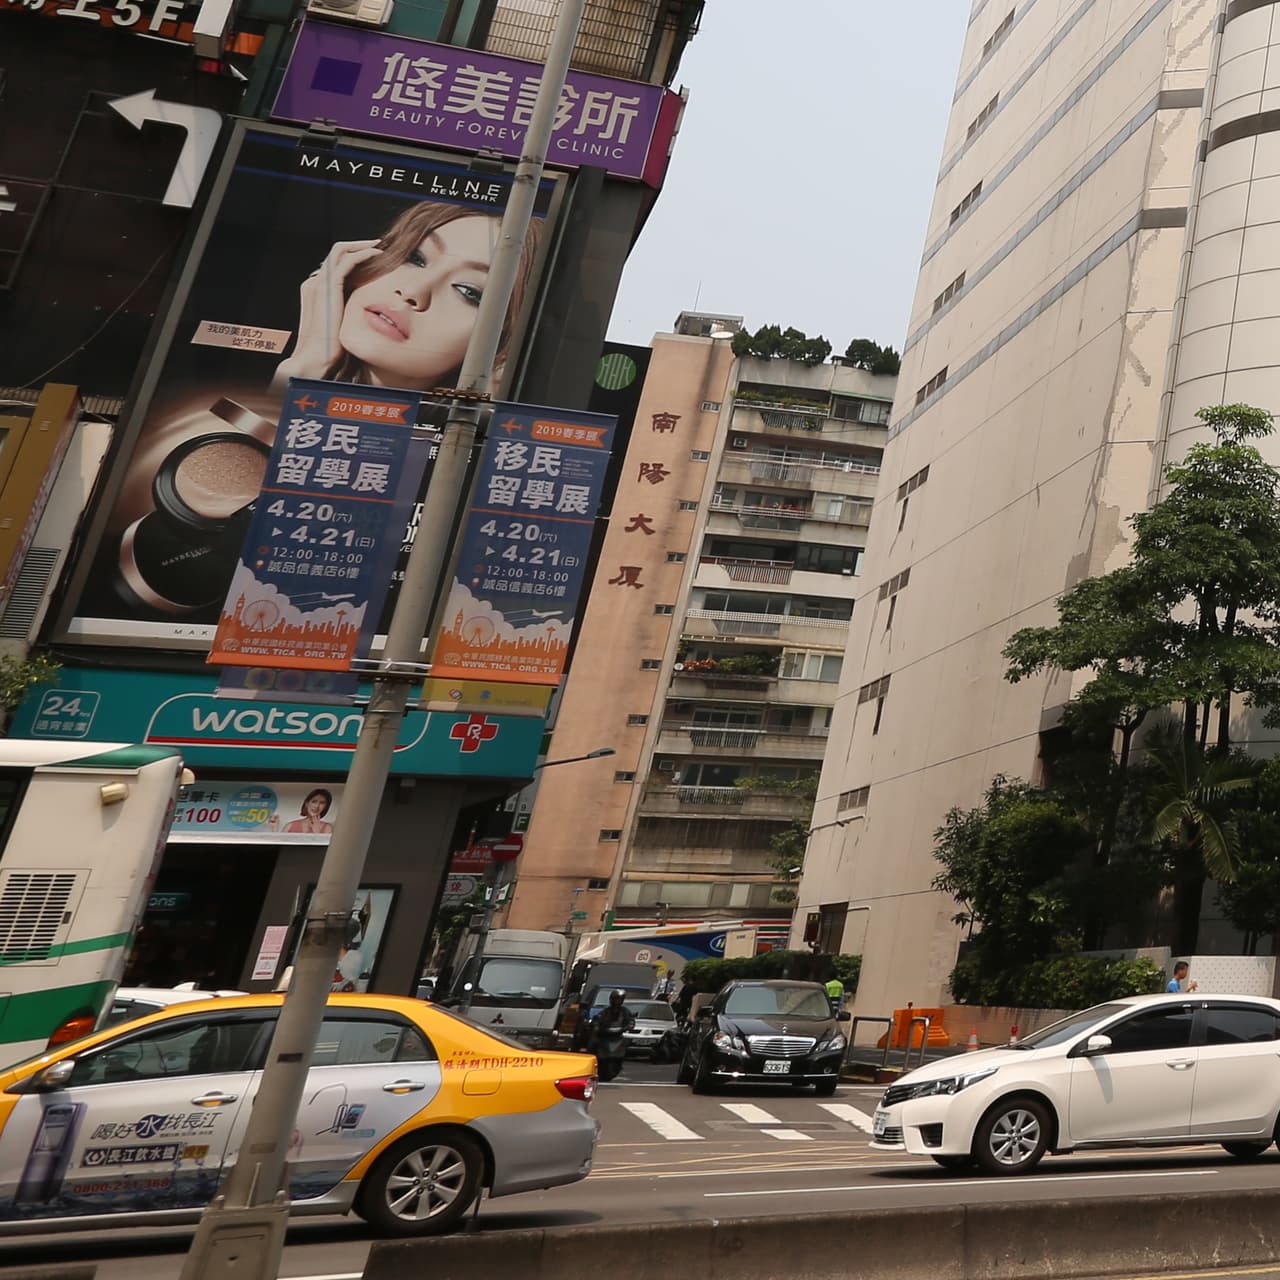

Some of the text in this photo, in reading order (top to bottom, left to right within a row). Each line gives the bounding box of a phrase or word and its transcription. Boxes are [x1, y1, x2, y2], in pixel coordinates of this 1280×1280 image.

[372, 52, 641, 145] 悠美診所
[369, 106, 625, 160] BEAUTY FOREV CLINIC
[300, 154, 502, 198] MAYBELLINE
[430, 187, 498, 202] NEW YORK
[285, 418, 360, 455] 移民
[276, 453, 391, 494] 留學展
[494, 440, 562, 477] 移民
[487, 474, 590, 515] 留學展
[42, 696, 82, 717] 24
[192, 705, 364, 737] watson
[186, 808, 222, 823] 100
[483, 1056, 544, 1069] TDH-2210
